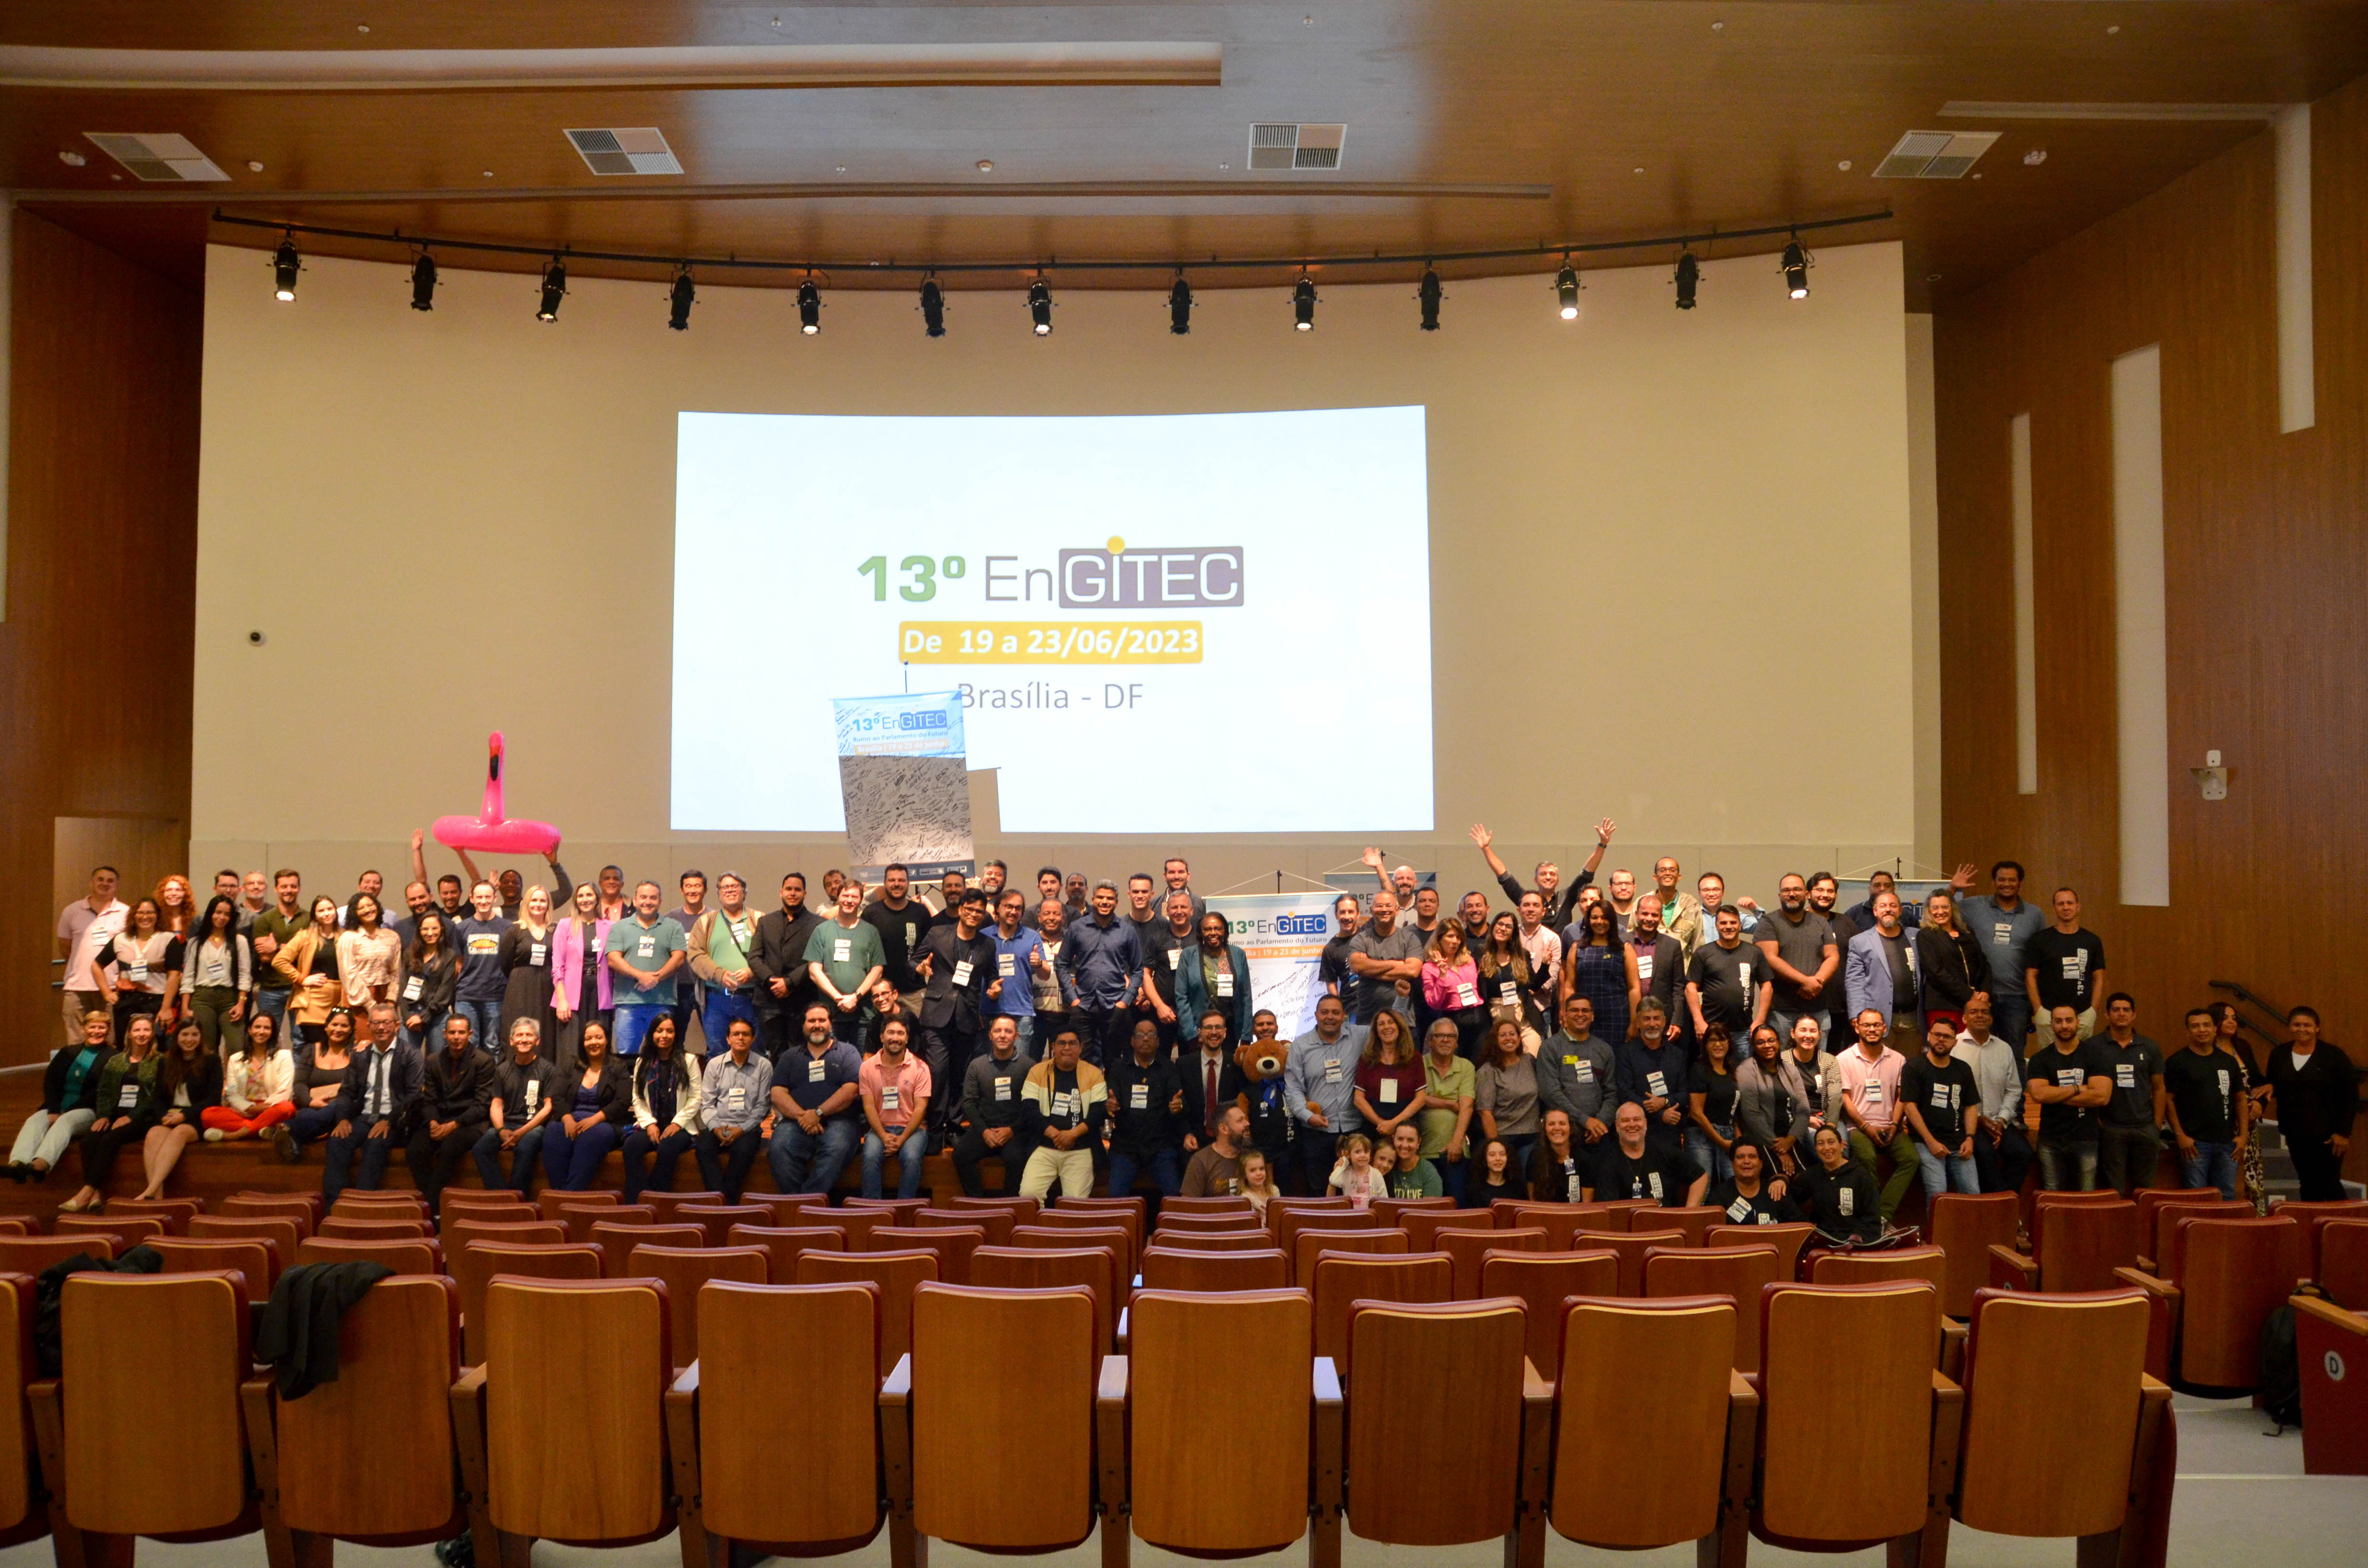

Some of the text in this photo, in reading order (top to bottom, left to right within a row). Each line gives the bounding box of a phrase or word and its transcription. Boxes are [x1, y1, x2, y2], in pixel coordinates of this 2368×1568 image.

[904, 626, 1198, 659] De 19 a 23/06/2023
[958, 681, 1069, 709] Brasília
[1104, 684, 1144, 709] DF
[1302, 947, 1323, 956] junho
[2330, 1356, 2339, 1374] D
